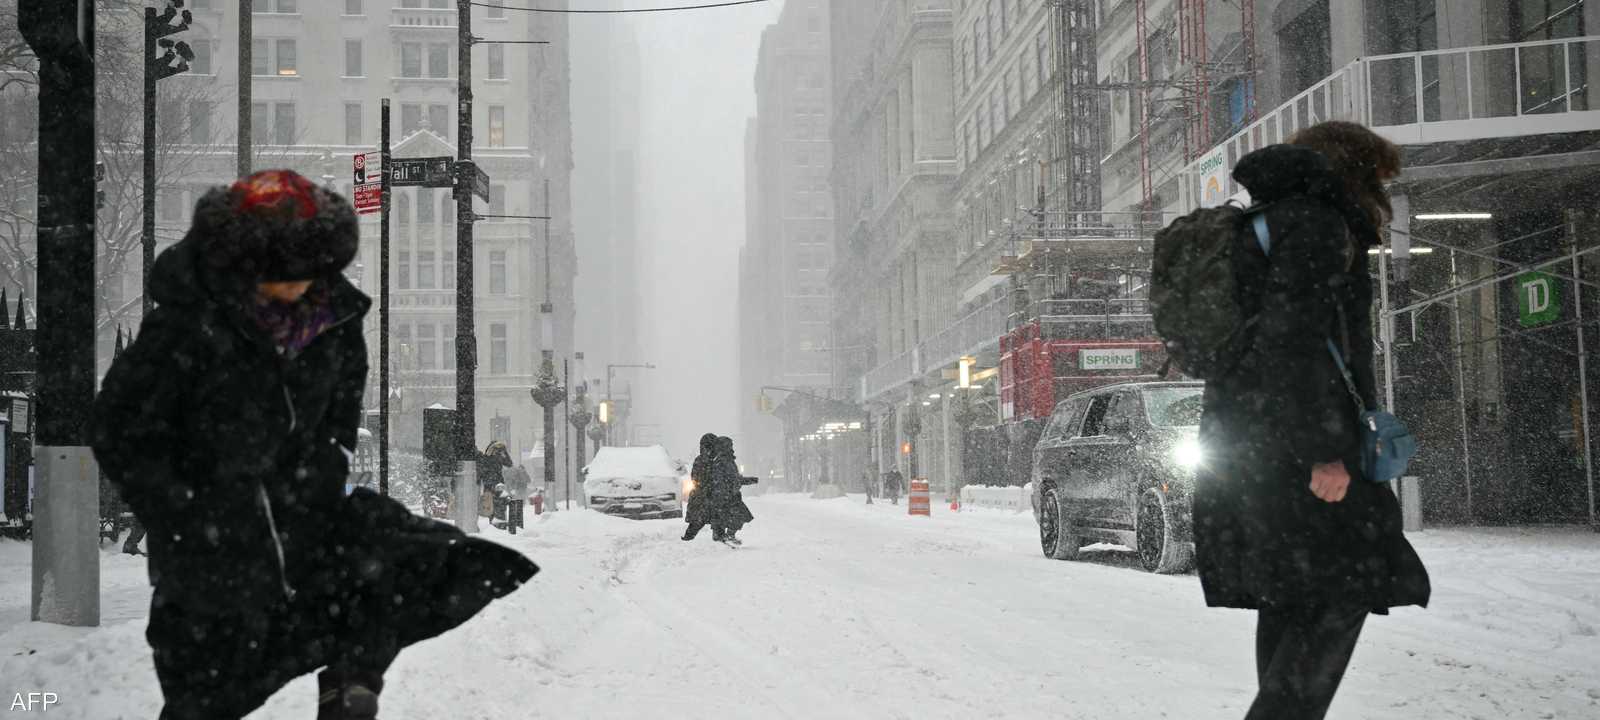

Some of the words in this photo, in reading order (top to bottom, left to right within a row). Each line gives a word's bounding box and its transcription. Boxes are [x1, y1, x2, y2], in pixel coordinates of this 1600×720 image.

[1201, 153, 1223, 175] SPRING
[390, 167, 408, 180] all
[1522, 279, 1549, 314] TD
[1086, 355, 1133, 365] SPRING
